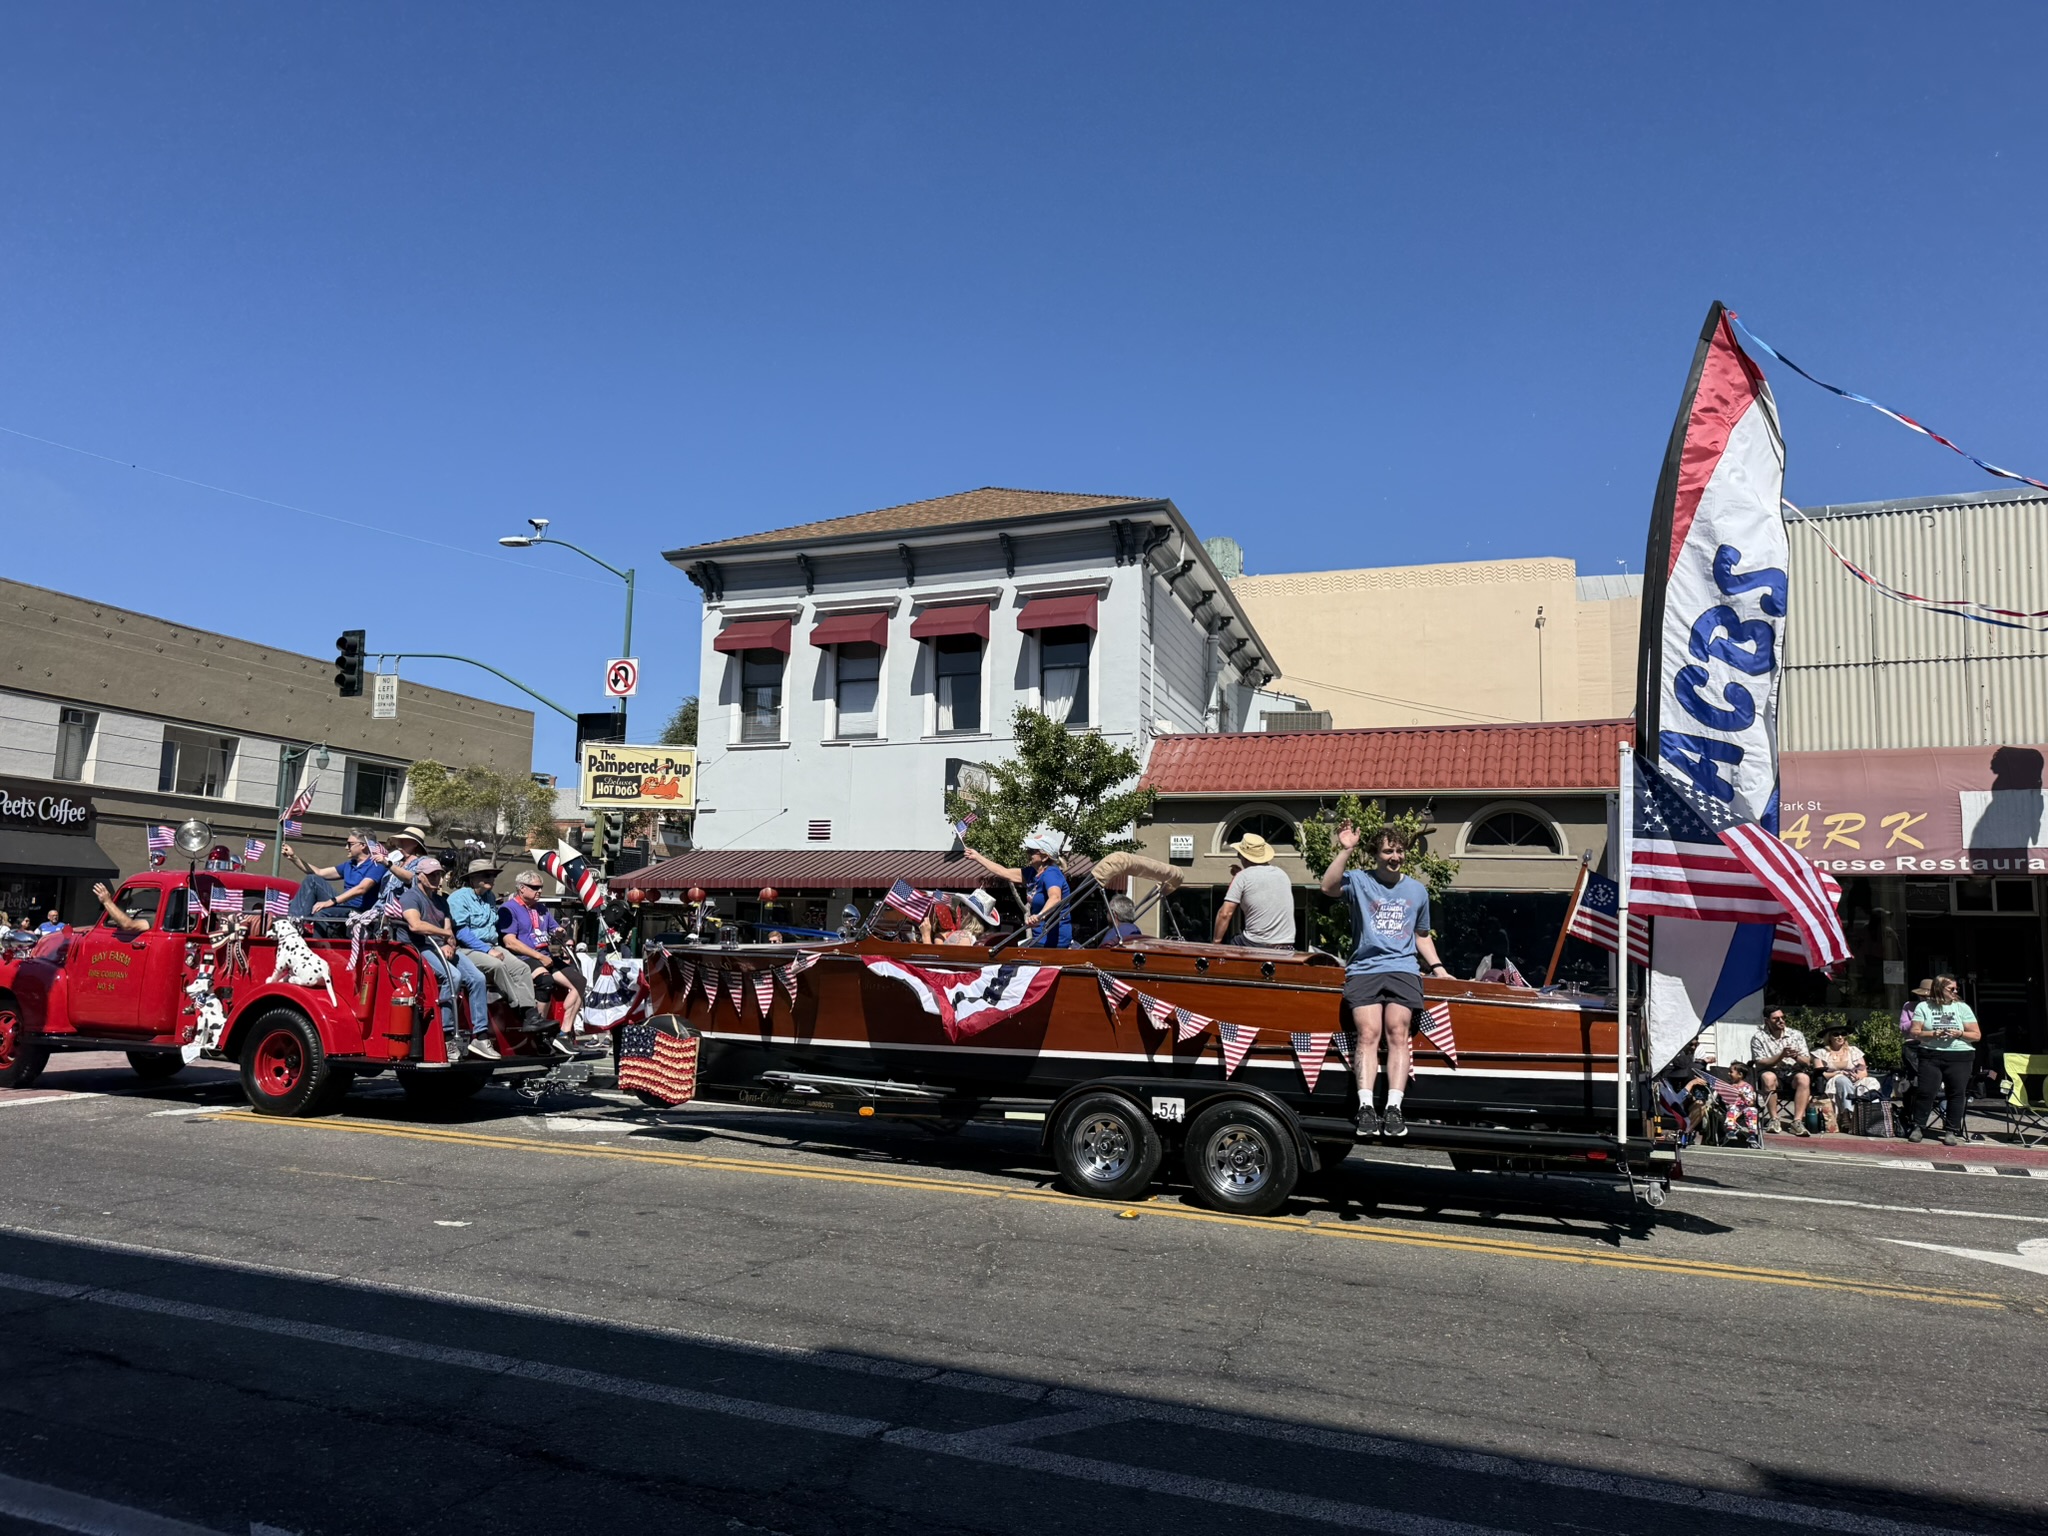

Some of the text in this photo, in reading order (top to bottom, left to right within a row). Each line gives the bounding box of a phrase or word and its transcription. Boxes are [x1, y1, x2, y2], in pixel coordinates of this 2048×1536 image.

[1660, 544, 1787, 804] ACBS
[600, 750, 616, 760] The
[588, 755, 691, 777] Pampered Pup
[604, 777, 633, 786] Deluxe
[596, 782, 638, 796] HOT DOGS
[38, 796, 86, 824] Coffee
[1807, 800, 1821, 811] St
[1780, 812, 1927, 850] ARK
[1805, 856, 1885, 871] nese
[1376, 911, 1403, 920] JULY 4TH
[1376, 919, 1388, 930] 5K
[91, 950, 132, 966] BAY FARM
[100, 970, 129, 979] COMPANY
[1160, 1102, 1178, 1118] 54
